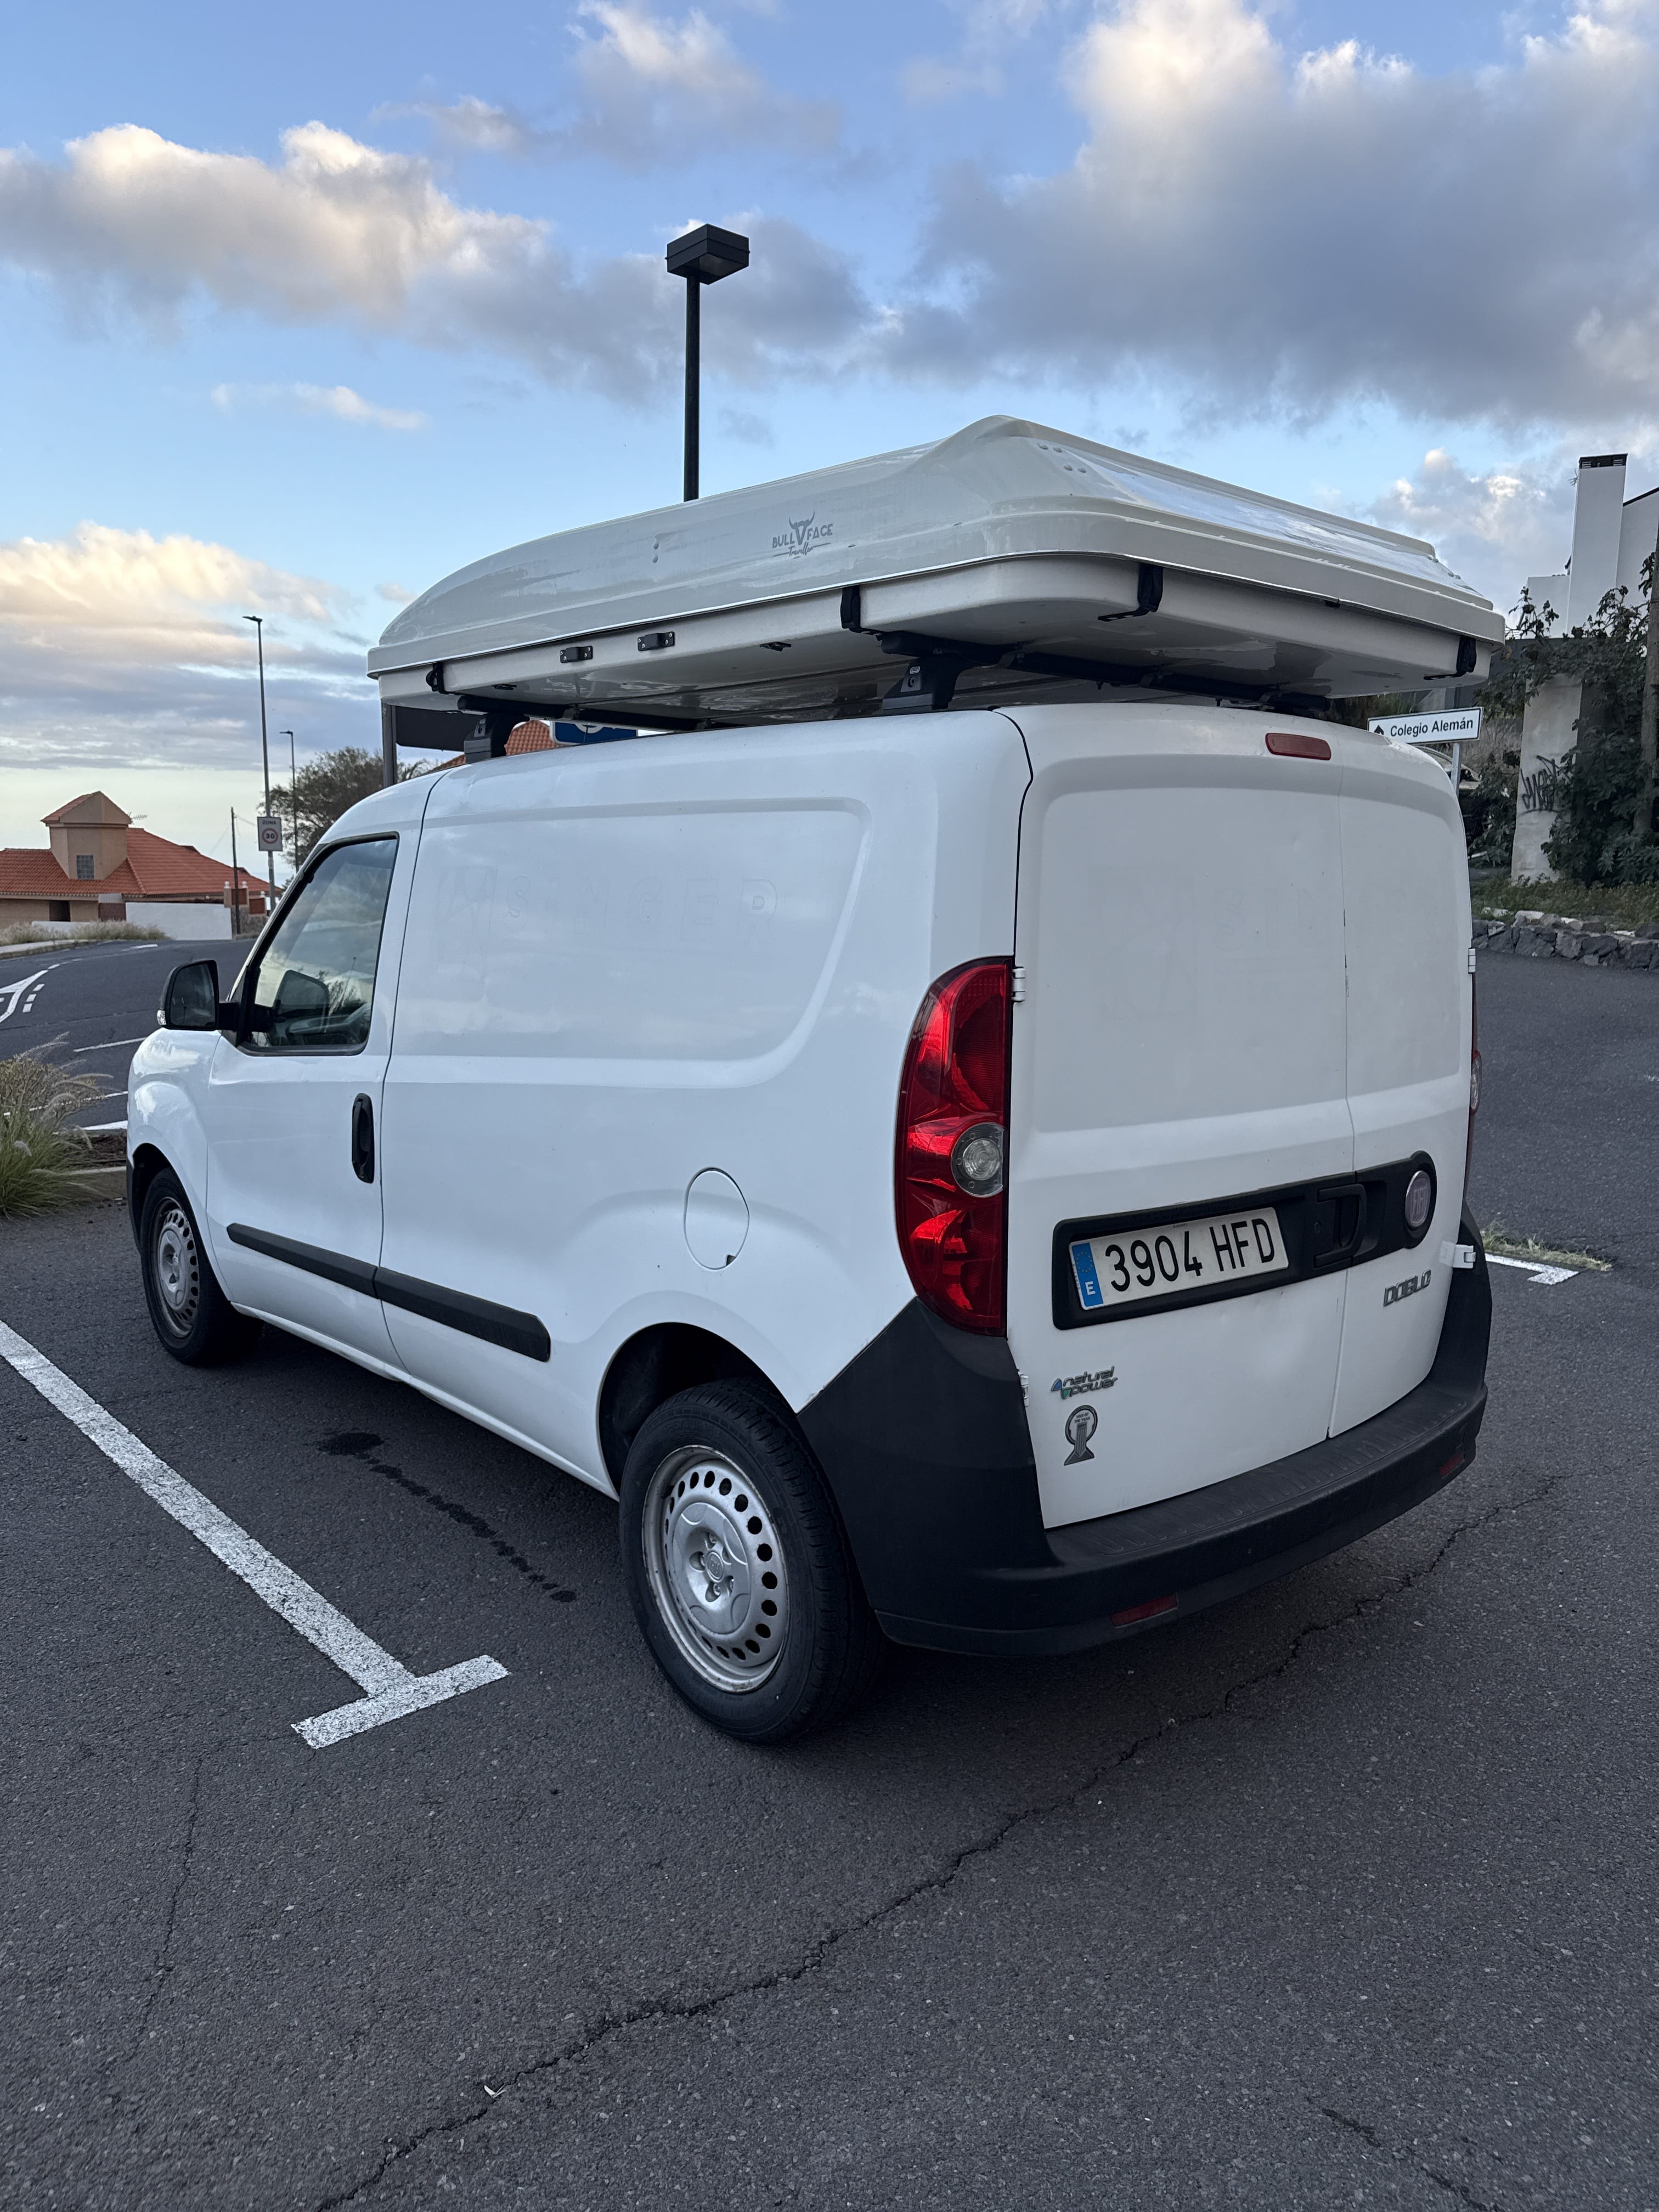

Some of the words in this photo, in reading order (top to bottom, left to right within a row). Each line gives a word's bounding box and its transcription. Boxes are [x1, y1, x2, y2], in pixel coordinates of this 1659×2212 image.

[772, 533, 795, 549] BULL
[807, 523, 833, 540] FACE
[788, 541, 813, 557] Traveller
[1390, 722, 1428, 738] Colegio
[1431, 716, 1474, 733] Alemán
[1105, 1231, 1203, 1293] 3904
[1209, 1218, 1275, 1272] HFD
[1085, 1280, 1096, 1296] E
[1383, 1268, 1432, 1307] DOBLO
[1063, 1365, 1115, 1387] natural
[1069, 1376, 1119, 1397] power
